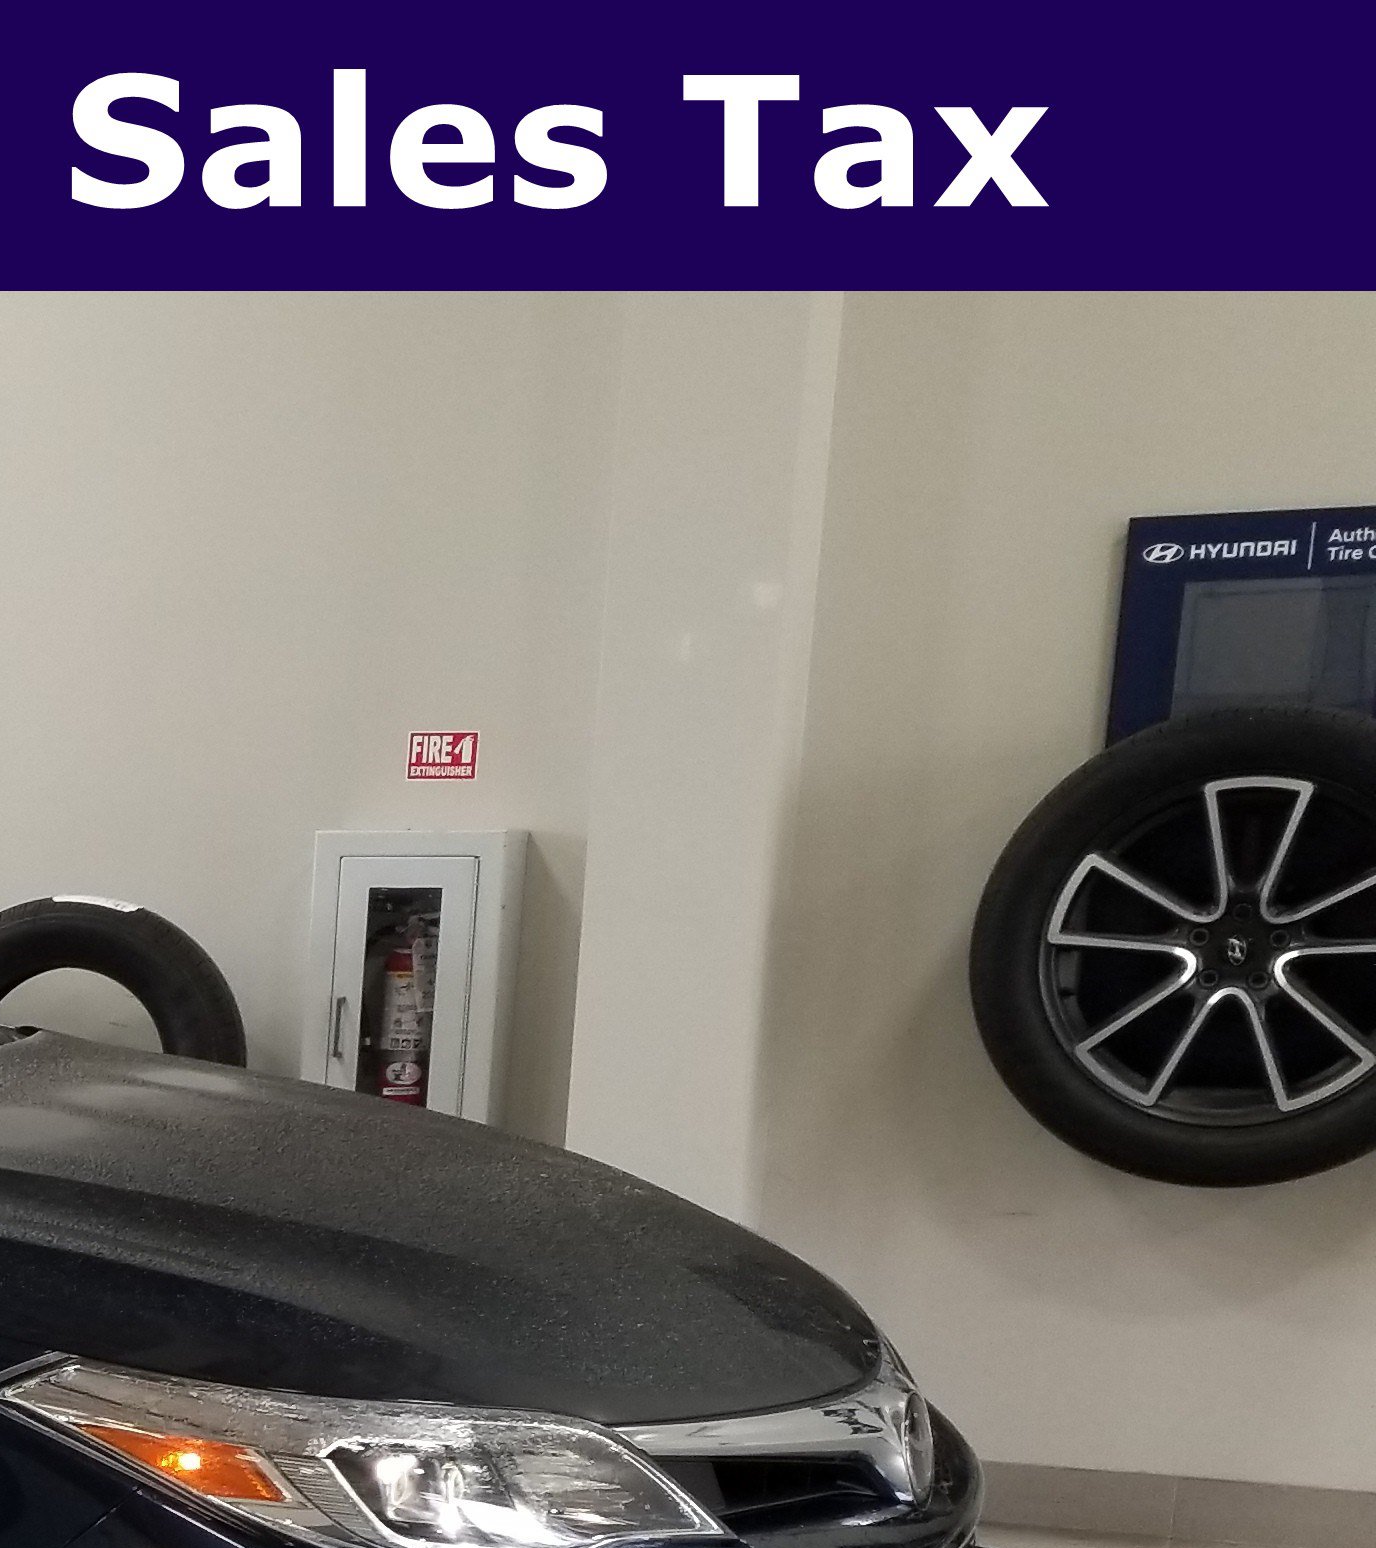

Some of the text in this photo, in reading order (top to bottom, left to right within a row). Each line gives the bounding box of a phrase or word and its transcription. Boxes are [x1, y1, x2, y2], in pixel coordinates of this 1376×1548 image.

[1189, 539, 1298, 560] HYUNDAI
[1327, 545, 1364, 562] Tire
[411, 735, 454, 764] FIRE
[410, 765, 473, 777] EXTINGUISHER
